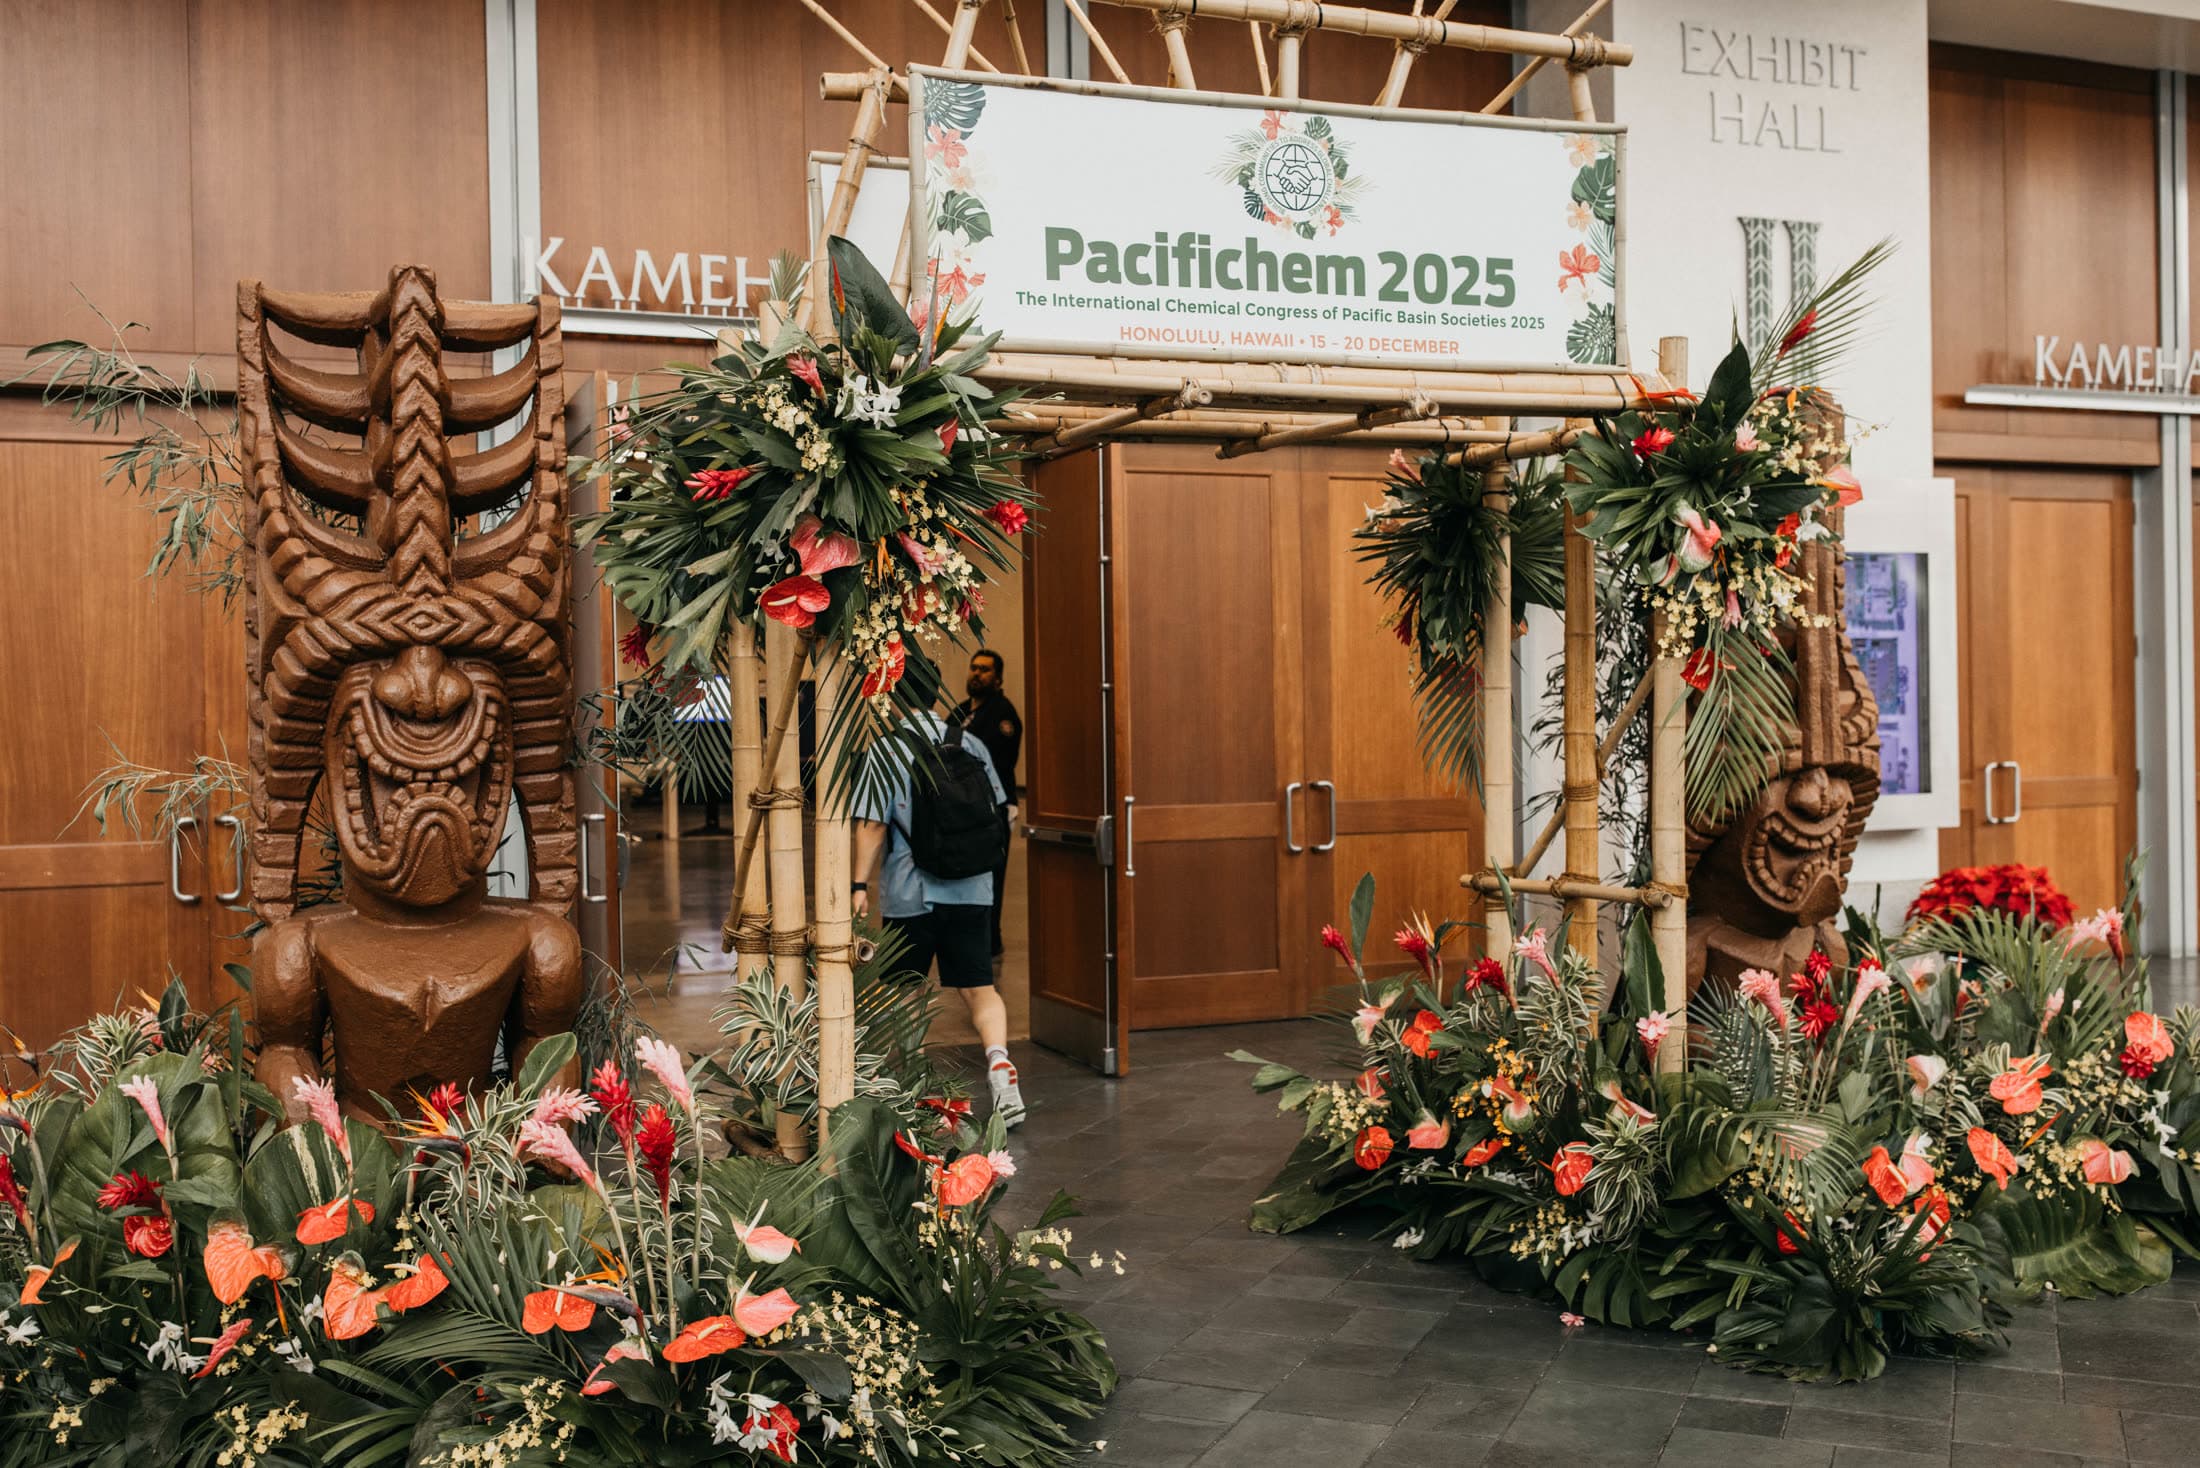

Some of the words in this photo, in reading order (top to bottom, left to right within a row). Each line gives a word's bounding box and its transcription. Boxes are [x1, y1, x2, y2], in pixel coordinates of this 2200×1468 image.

[1680, 20, 1868, 92] EXHIBIT
[1709, 90, 1842, 153] HALL
[523, 236, 813, 314] KAMEH
[1045, 227, 1365, 296] Pacifichem
[1378, 251, 1515, 307] 2025
[1016, 291, 1047, 306] The
[1053, 293, 1160, 311] International
[1166, 299, 1240, 315] Chemical
[1246, 303, 1317, 320] Congress
[1323, 307, 1338, 320] of
[1343, 308, 1392, 322] Pacific
[1398, 311, 1436, 324] Basin
[1441, 313, 1506, 327] Societies
[1511, 316, 1544, 329] 2025
[1120, 326, 1224, 346] HONOLULU,
[1231, 332, 1293, 346] HAWAII
[1311, 336, 1325, 348] 15
[1344, 336, 1363, 350] 20
[1369, 337, 1459, 354] DECEMBER
